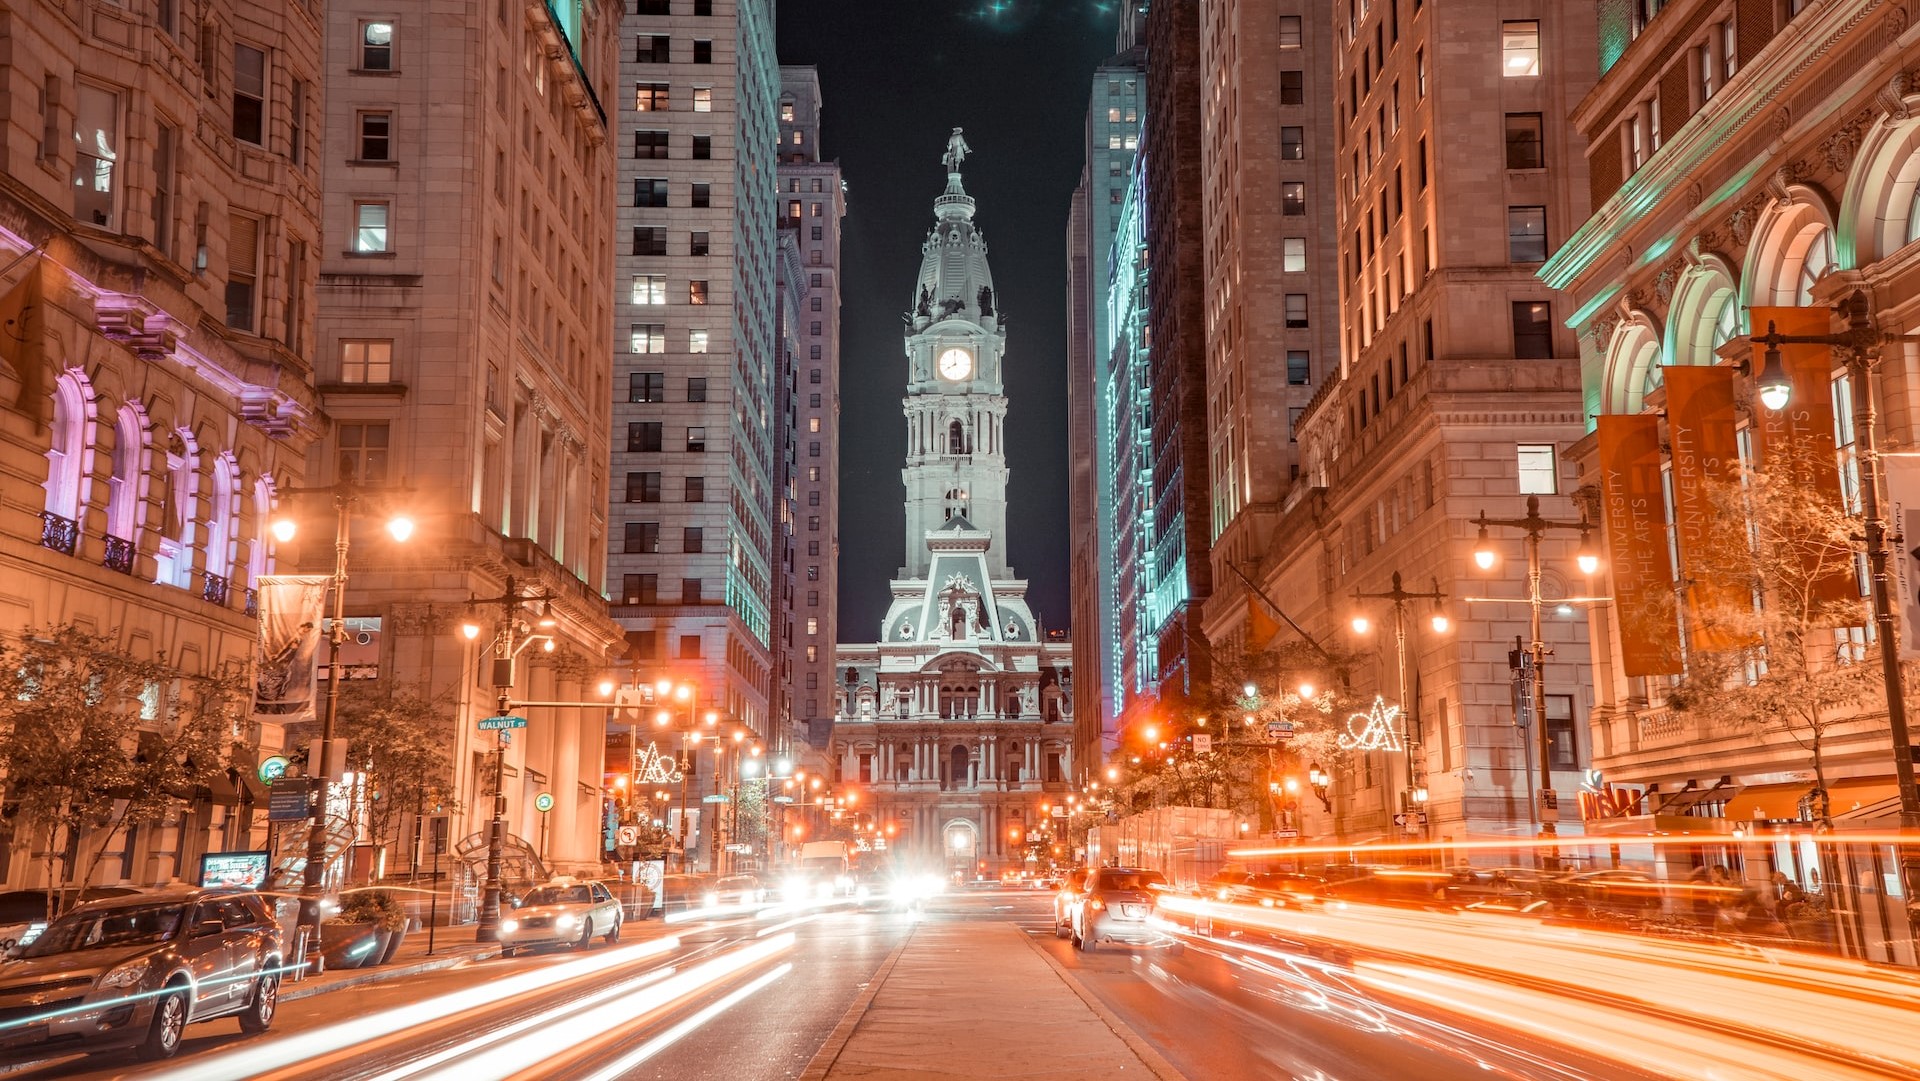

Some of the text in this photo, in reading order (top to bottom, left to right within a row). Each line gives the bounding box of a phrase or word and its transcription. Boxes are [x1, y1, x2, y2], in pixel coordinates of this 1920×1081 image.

[1676, 424, 1702, 538] UNIVERSITY
[1607, 469, 1636, 616] THE UNIVERSITY
[1631, 498, 1650, 543] ARTS
[1637, 550, 1655, 584] THE
[479, 720, 515, 730] WALNUT
